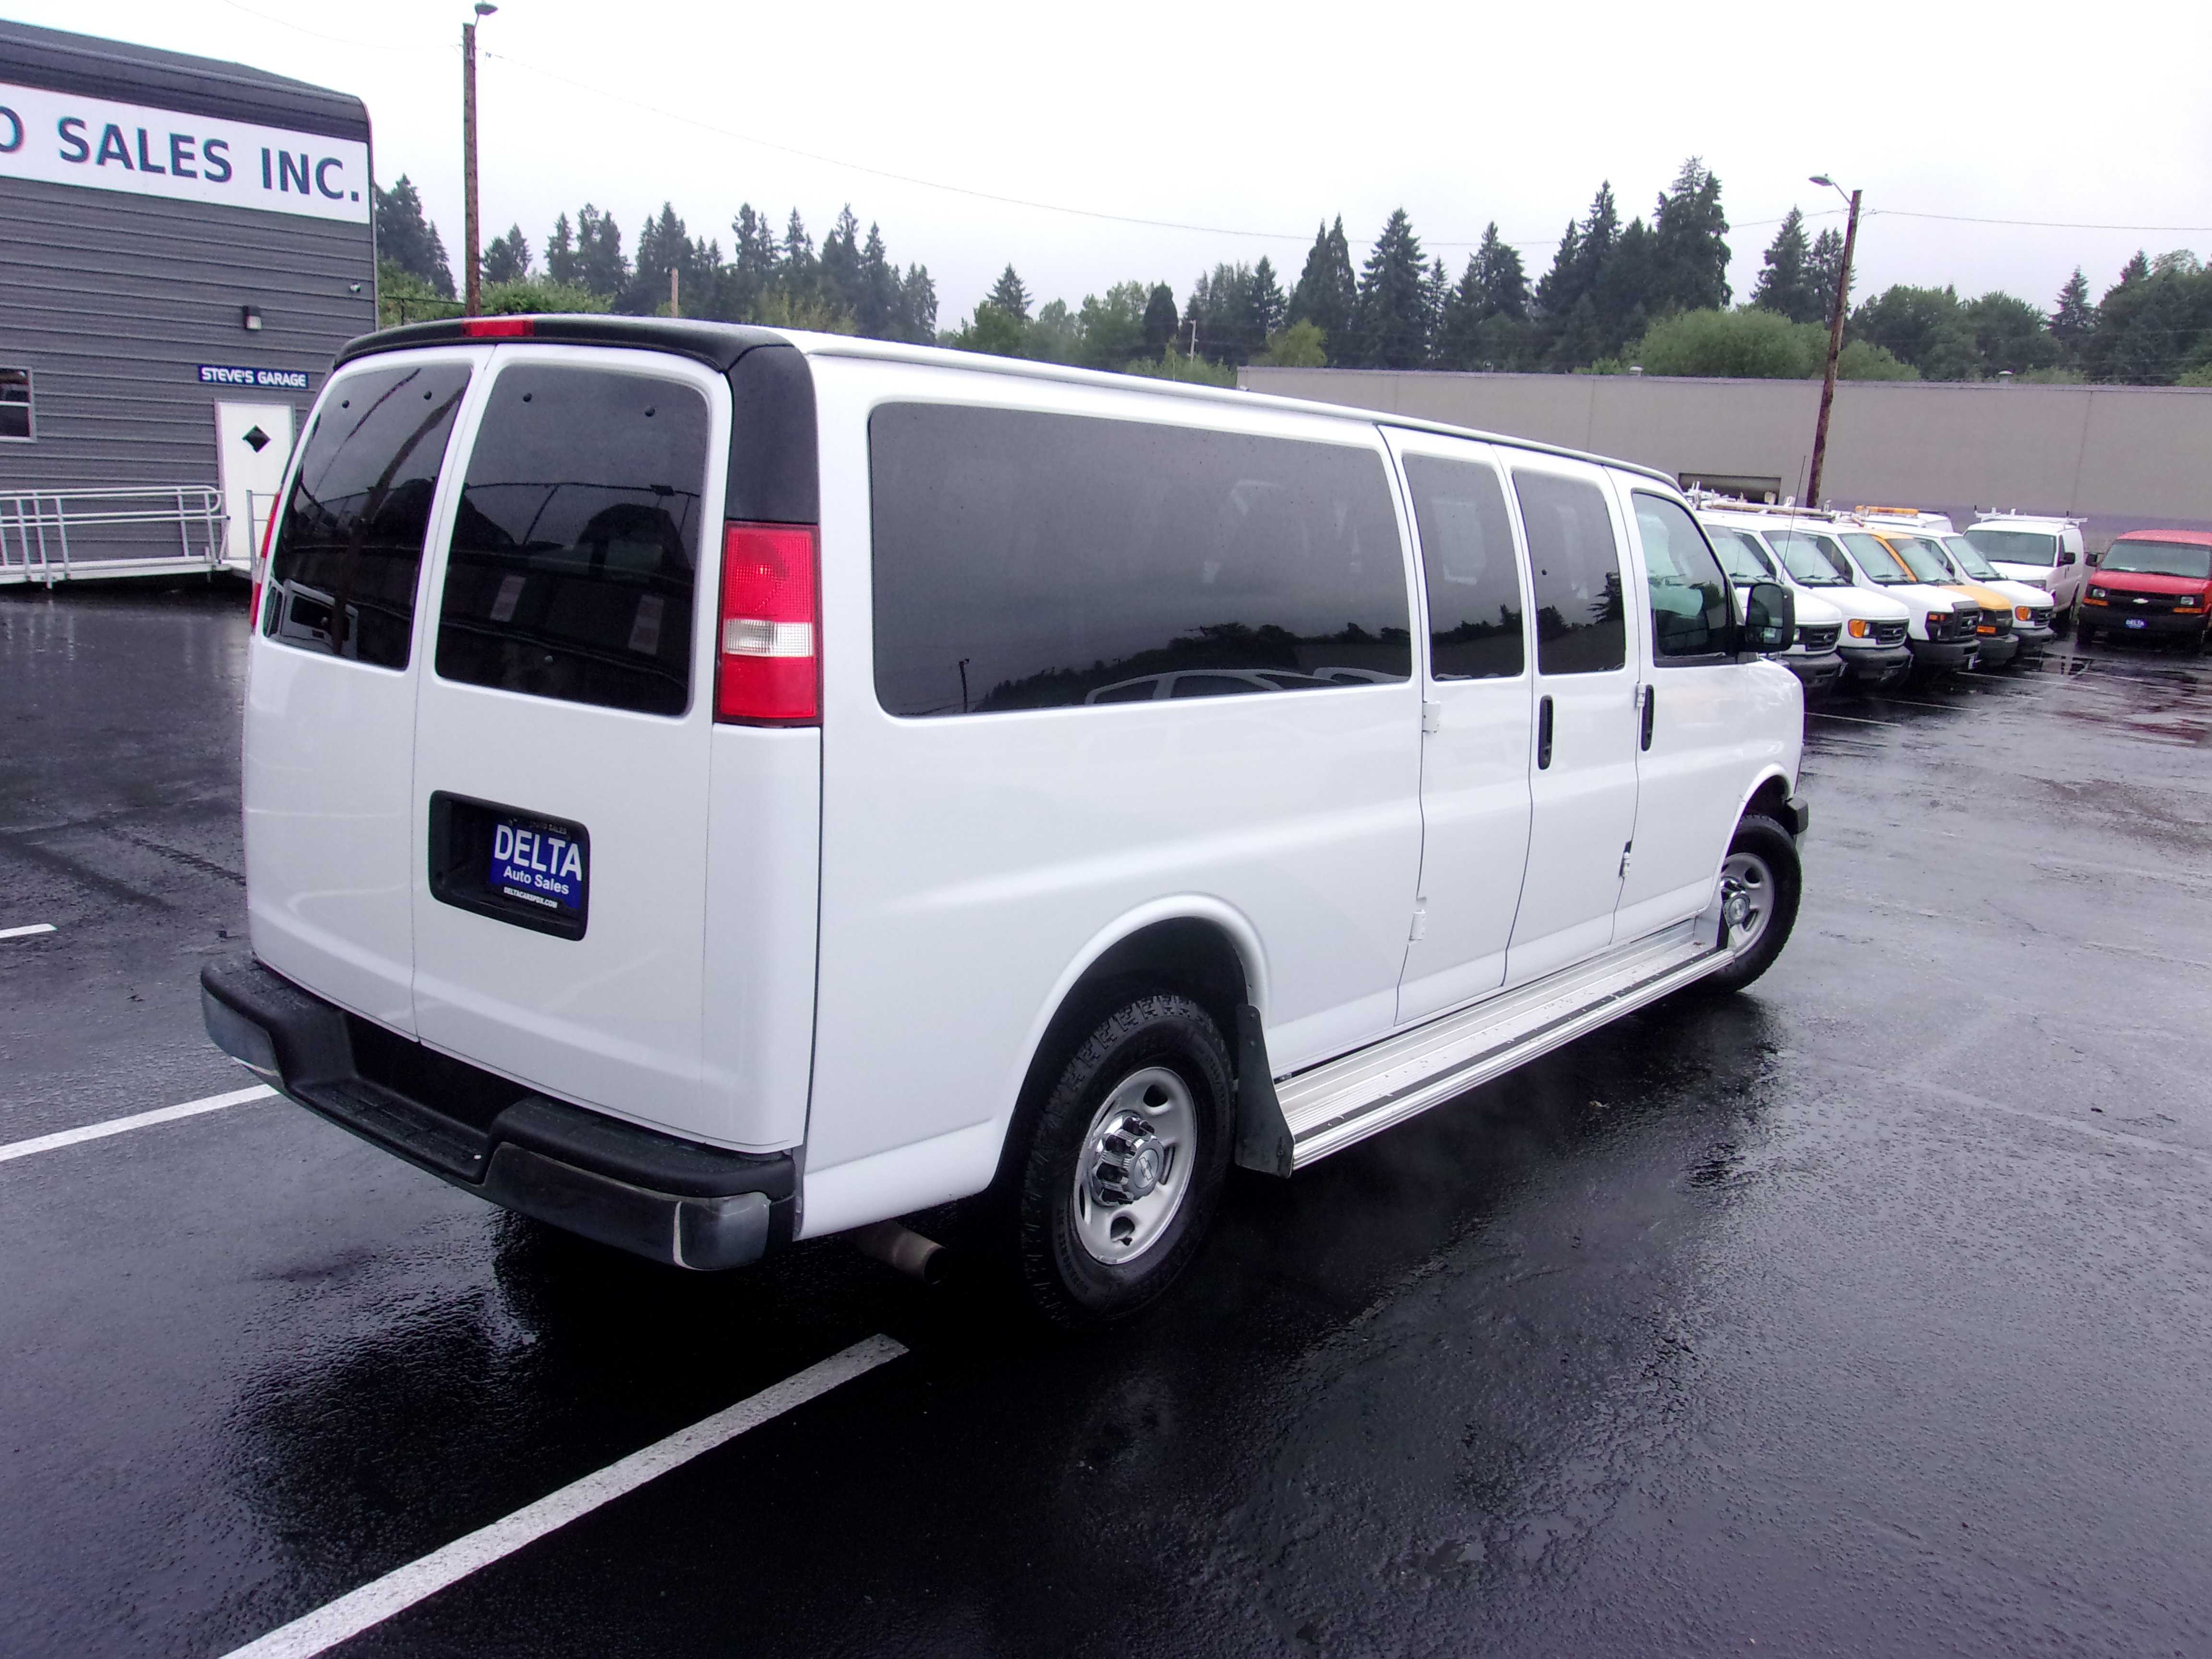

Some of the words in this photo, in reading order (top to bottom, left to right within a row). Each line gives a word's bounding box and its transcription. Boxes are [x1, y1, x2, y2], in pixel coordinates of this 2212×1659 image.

[58, 116, 232, 183] SALES
[261, 147, 360, 202] INC.
[201, 367, 254, 384] STEVE'S
[257, 371, 307, 387] GARAGE
[494, 824, 582, 881] DELTA
[503, 866, 531, 884] Auto
[534, 874, 569, 895] Sales
